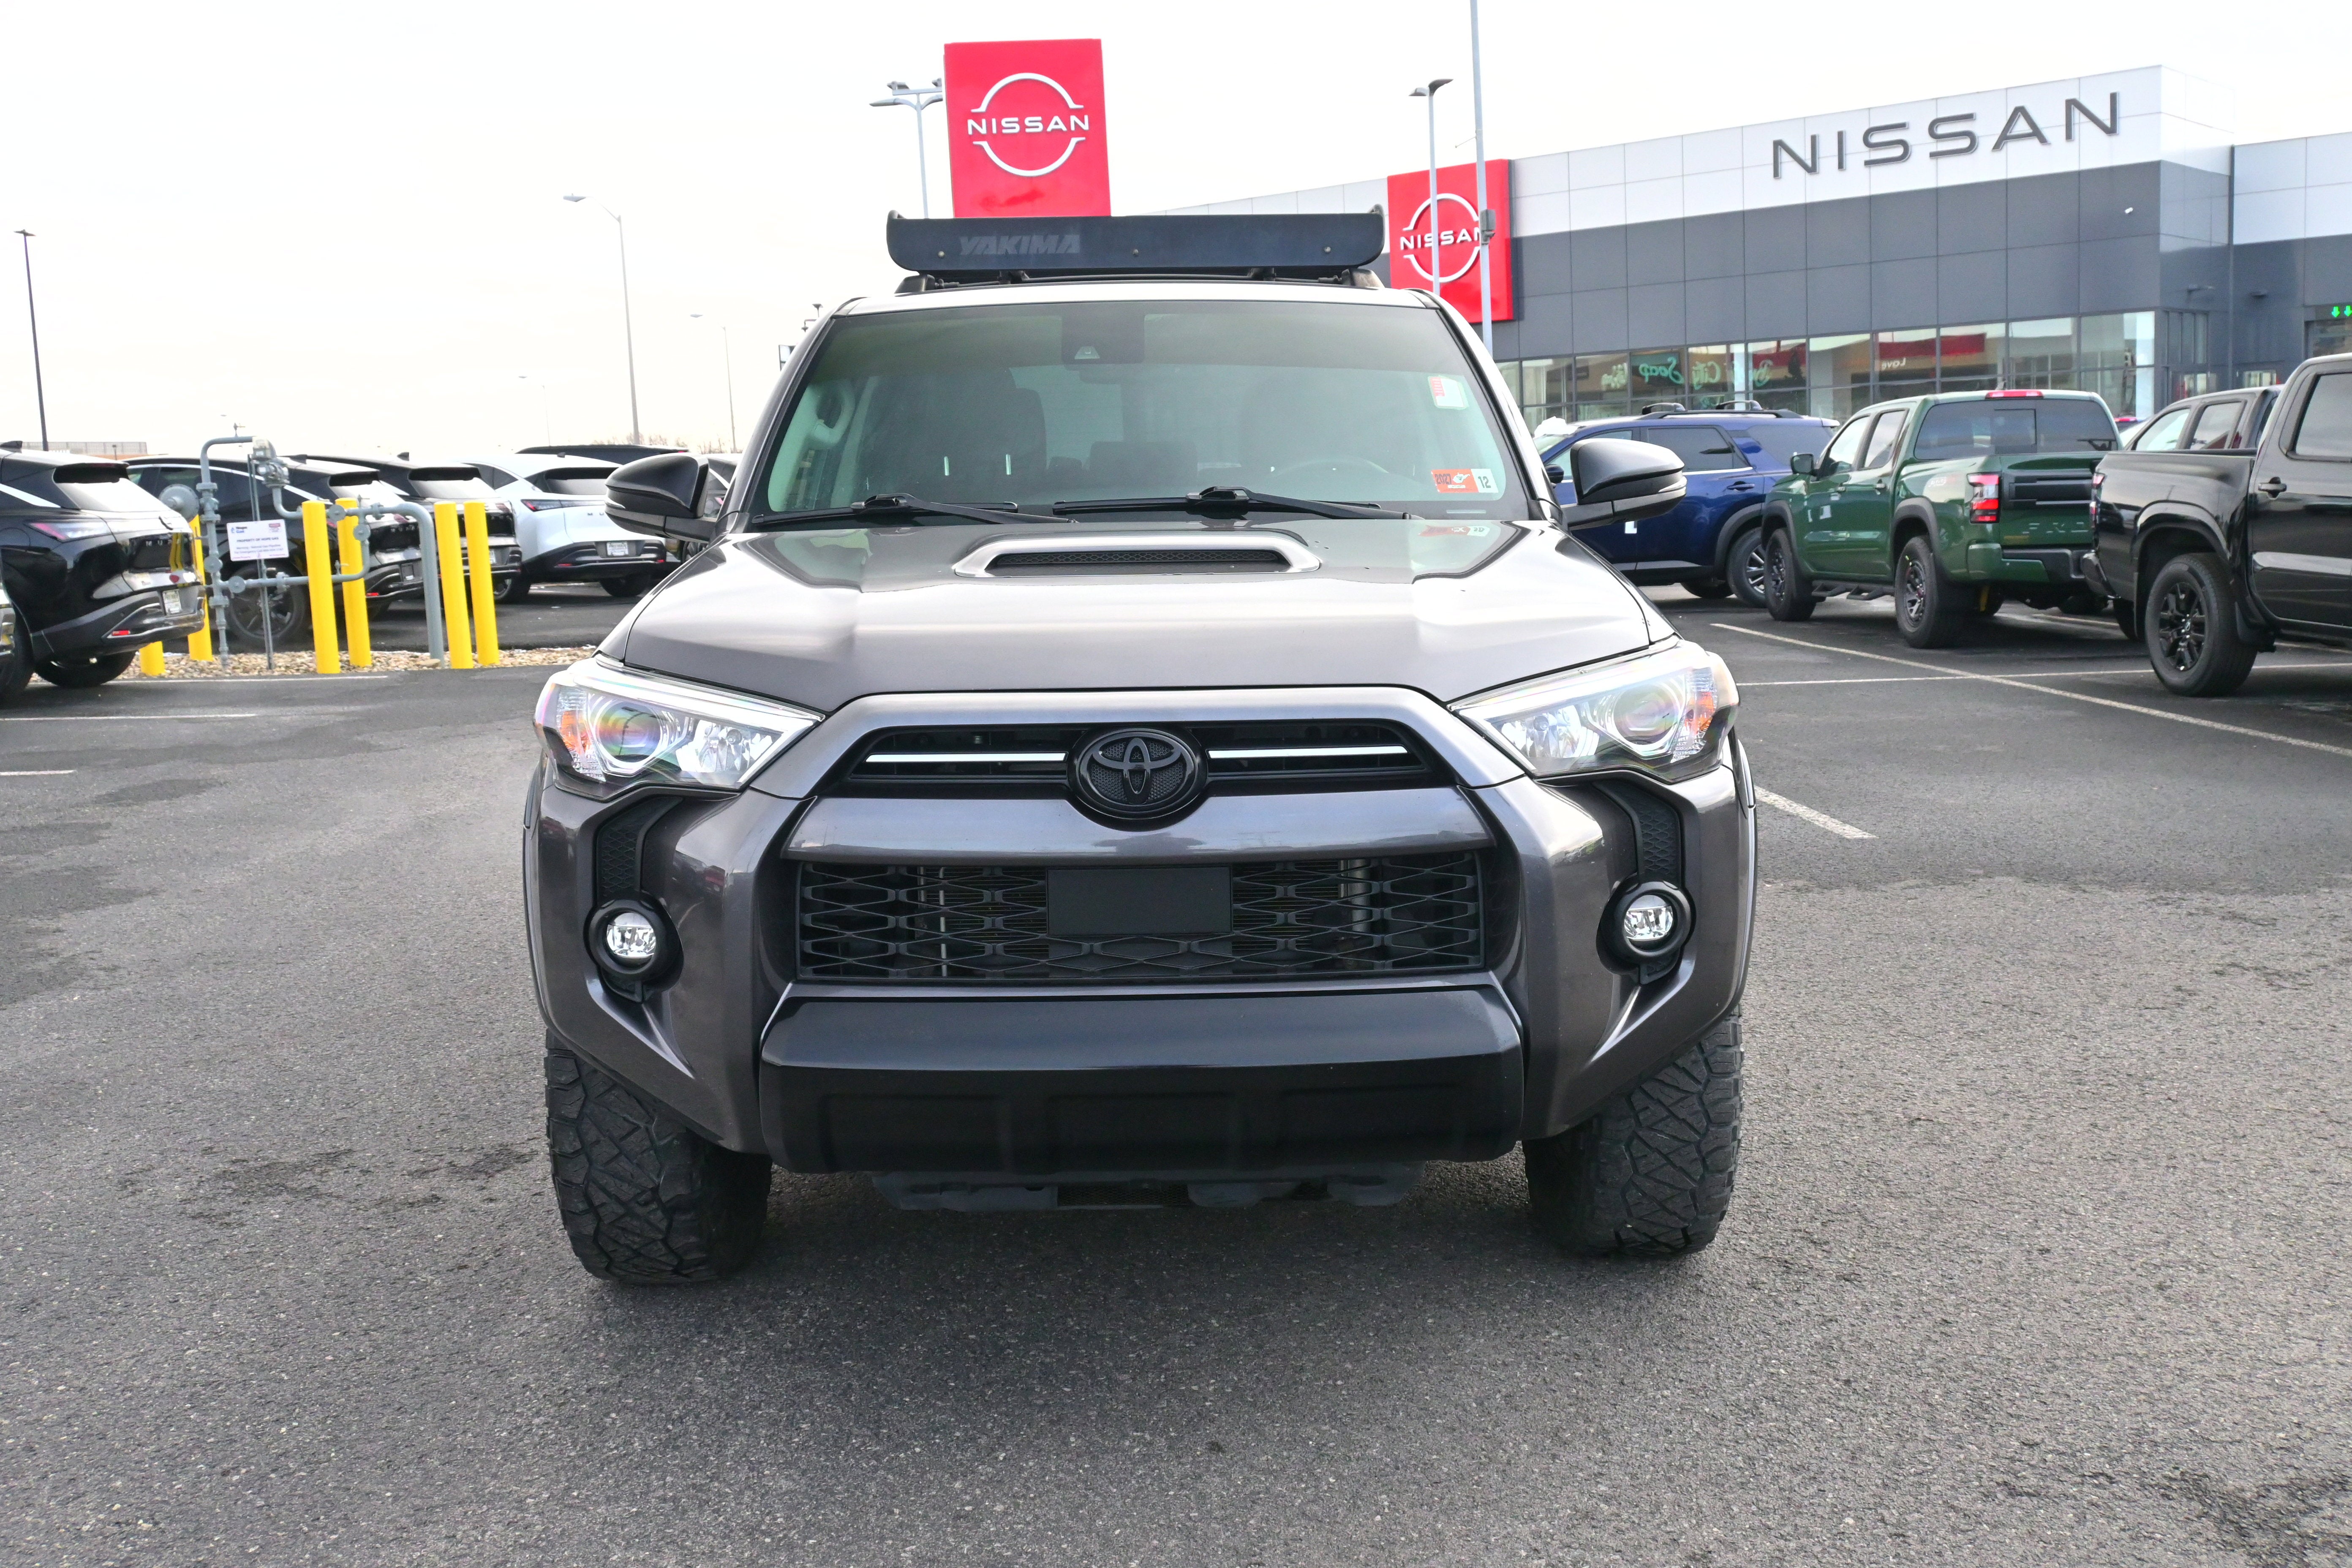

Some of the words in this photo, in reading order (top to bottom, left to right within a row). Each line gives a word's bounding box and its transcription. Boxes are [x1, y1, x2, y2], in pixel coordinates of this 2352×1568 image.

[967, 114, 1089, 135] NISSAN
[1773, 91, 2120, 179] NISSAN
[958, 234, 1081, 255] YAKIMA
[1435, 474, 1451, 485] 2027
[1478, 476, 1492, 488] 12
